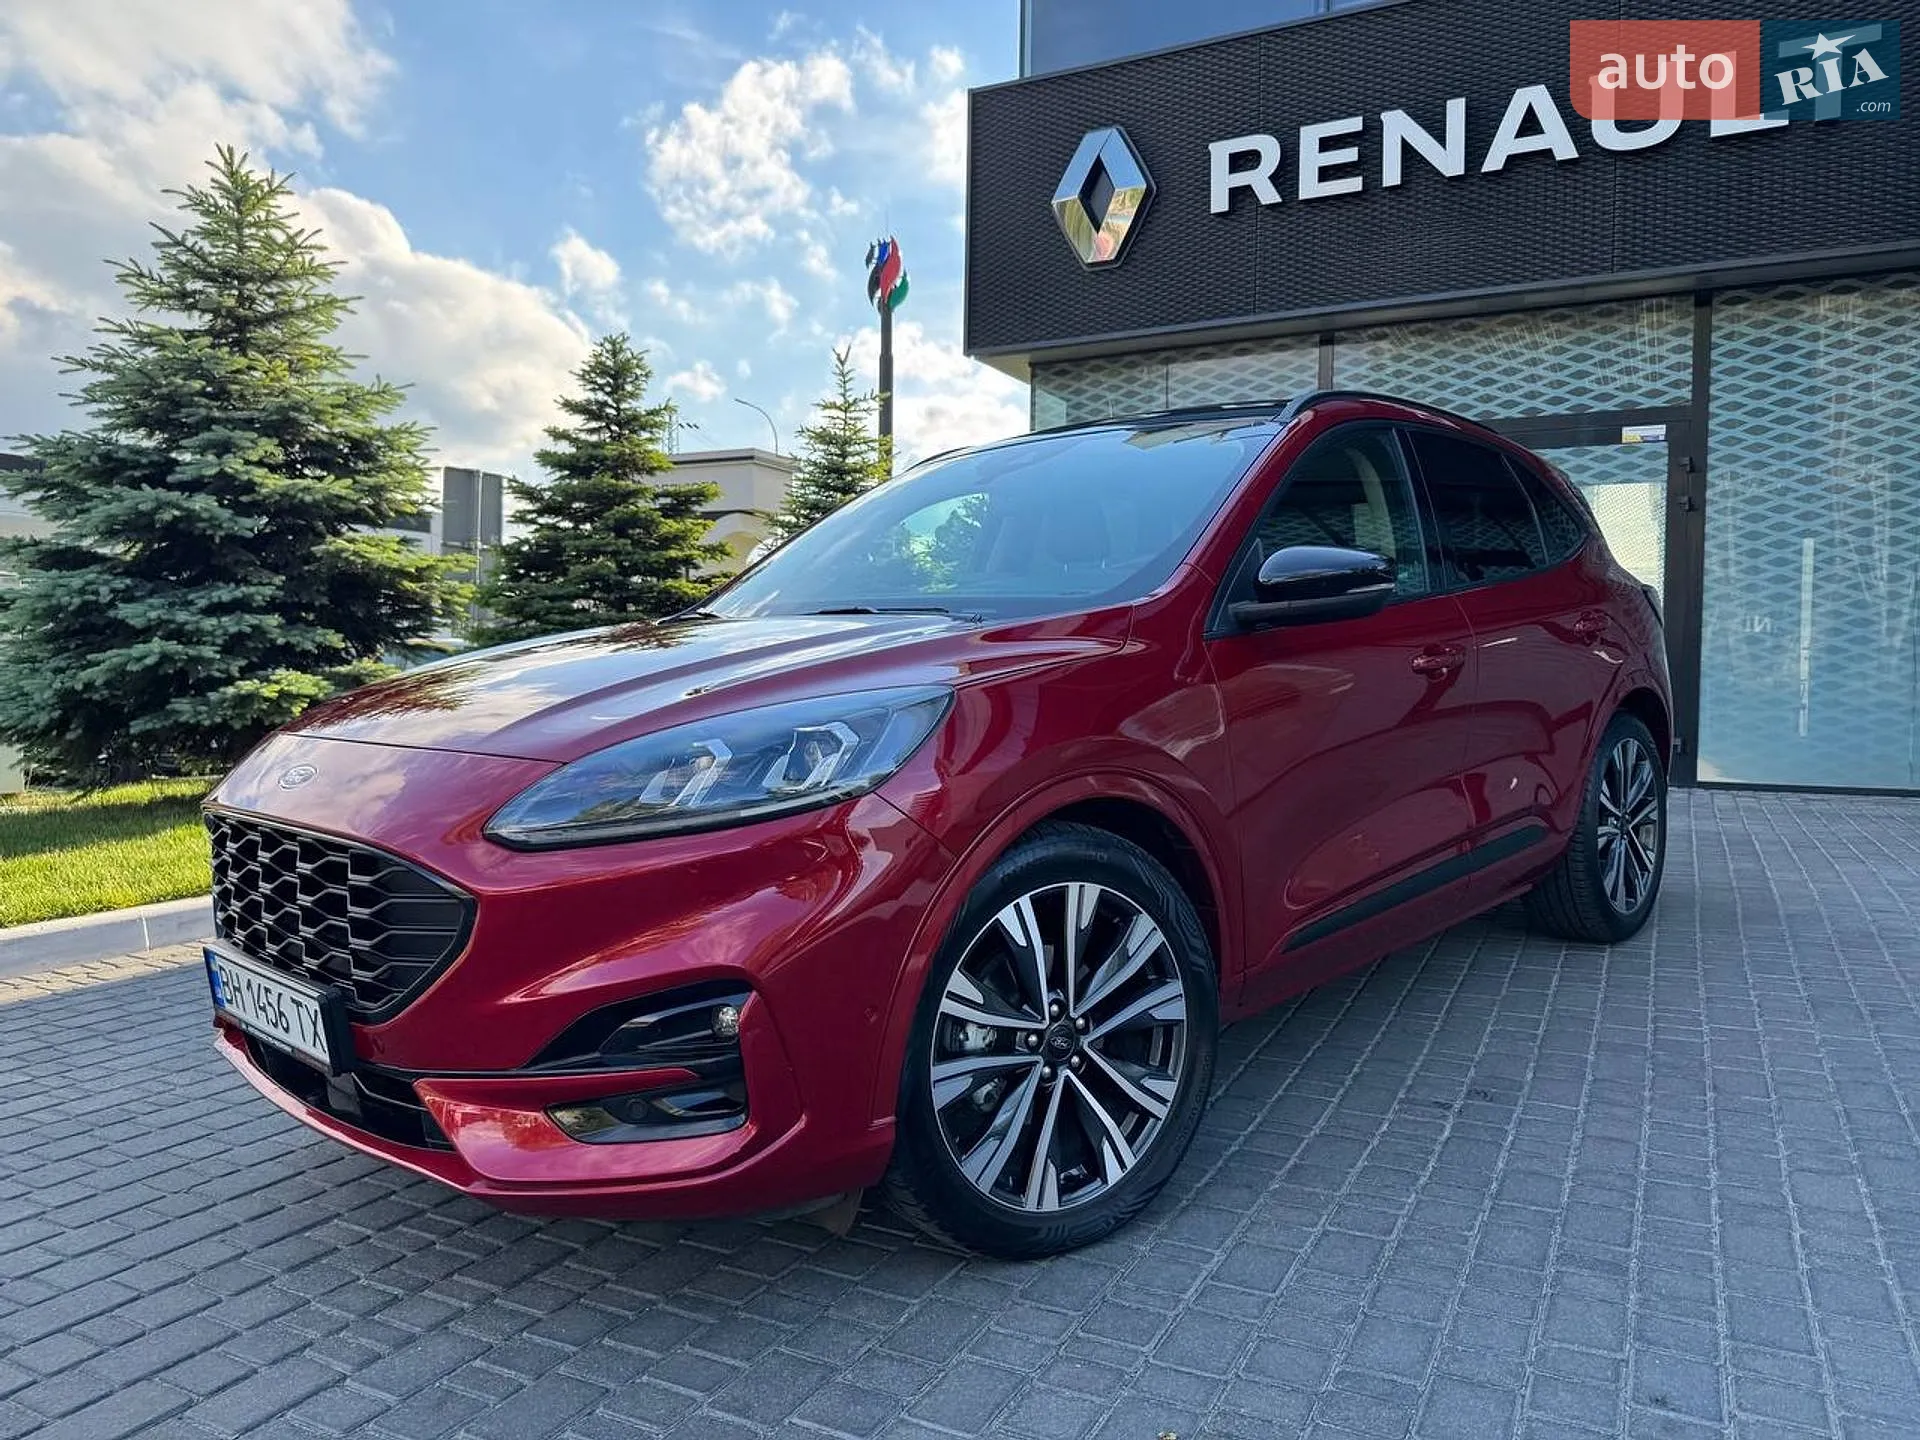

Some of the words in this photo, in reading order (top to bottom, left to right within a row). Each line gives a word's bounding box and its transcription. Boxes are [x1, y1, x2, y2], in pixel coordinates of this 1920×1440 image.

[1208, 24, 1882, 214] RENAULT
[218, 964, 247, 1015] BH
[246, 977, 290, 1035] 1456
[290, 996, 327, 1054] TX
